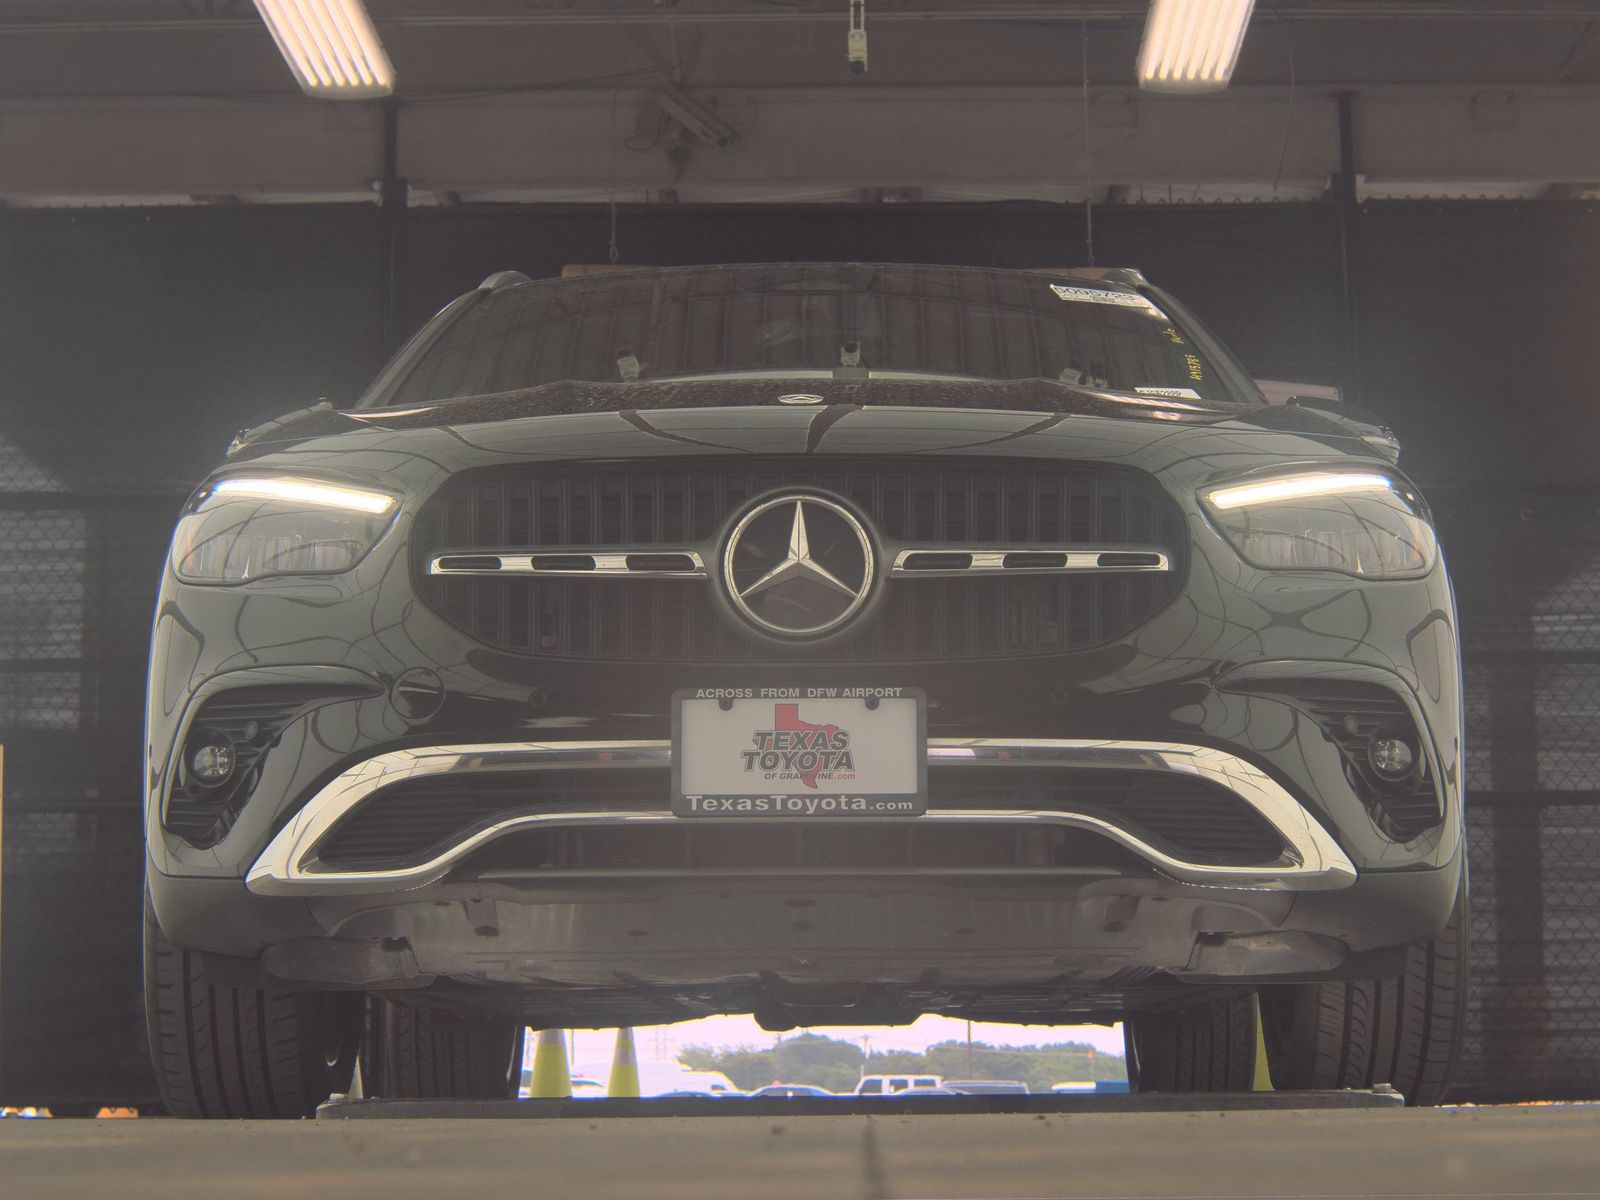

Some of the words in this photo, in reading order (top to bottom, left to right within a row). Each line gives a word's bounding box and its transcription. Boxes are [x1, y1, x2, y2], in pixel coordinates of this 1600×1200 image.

[696, 688, 753, 698] ACROSS
[760, 688, 800, 698] FROM
[807, 688, 837, 698] DFW
[842, 688, 902, 698] AIRPORT
[753, 730, 850, 751] TEXAS
[741, 750, 855, 772] TOYOTA
[686, 795, 913, 814] TexasToyota.com
